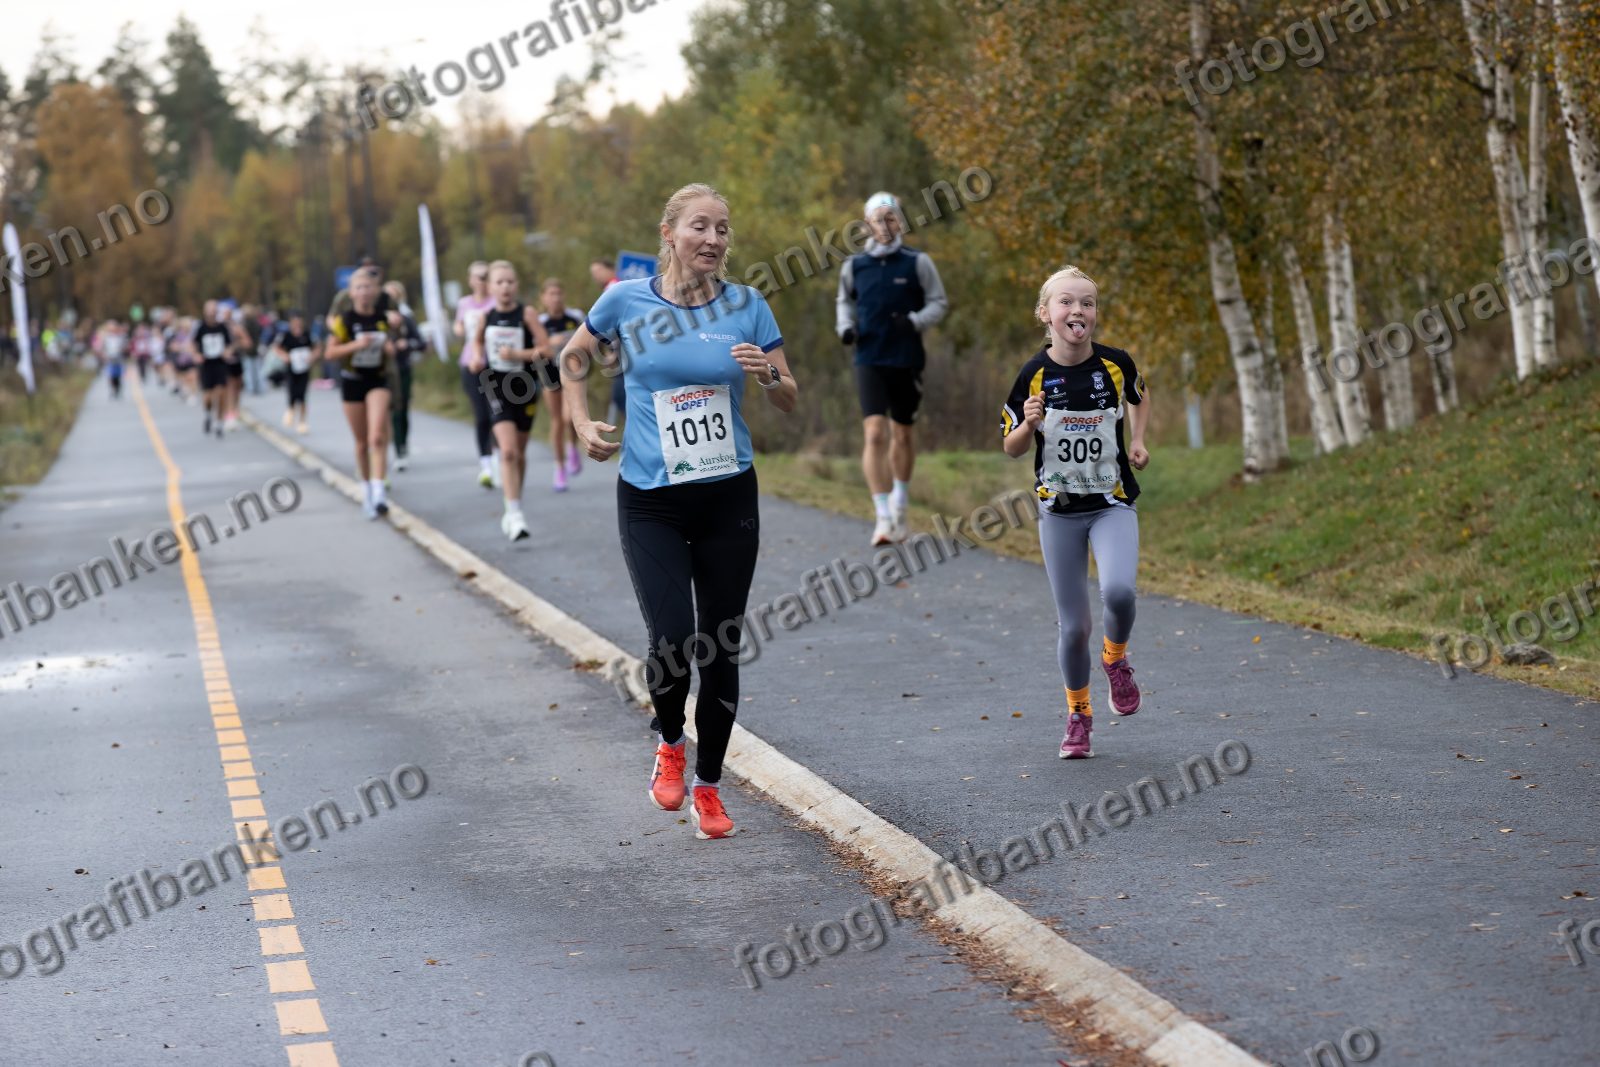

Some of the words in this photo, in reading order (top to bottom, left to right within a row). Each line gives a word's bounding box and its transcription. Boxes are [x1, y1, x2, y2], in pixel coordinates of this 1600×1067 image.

[670, 389, 715, 404] NORGES
[1061, 415, 1104, 424] NORGES
[666, 412, 727, 448] 1013
[1057, 437, 1103, 464] 309
[698, 453, 737, 467] Aurskog
